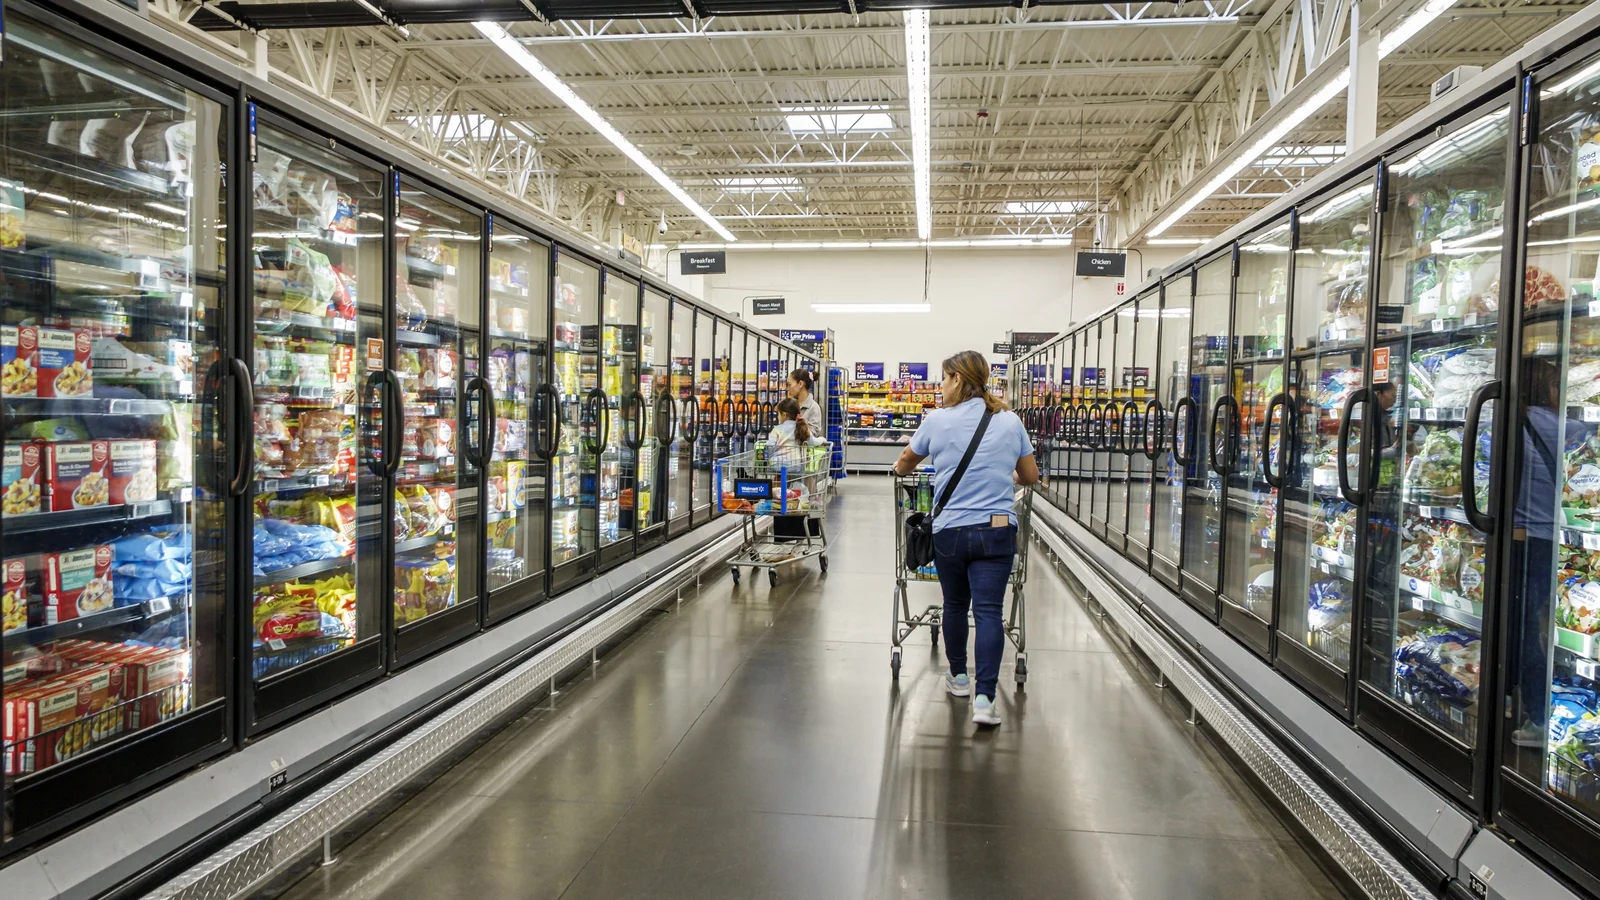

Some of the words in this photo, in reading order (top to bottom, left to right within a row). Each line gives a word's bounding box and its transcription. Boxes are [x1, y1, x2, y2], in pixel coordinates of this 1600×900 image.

[790, 331, 802, 339] Low
[371, 345, 381, 354] WIC
[1376, 355, 1386, 364] WIC
